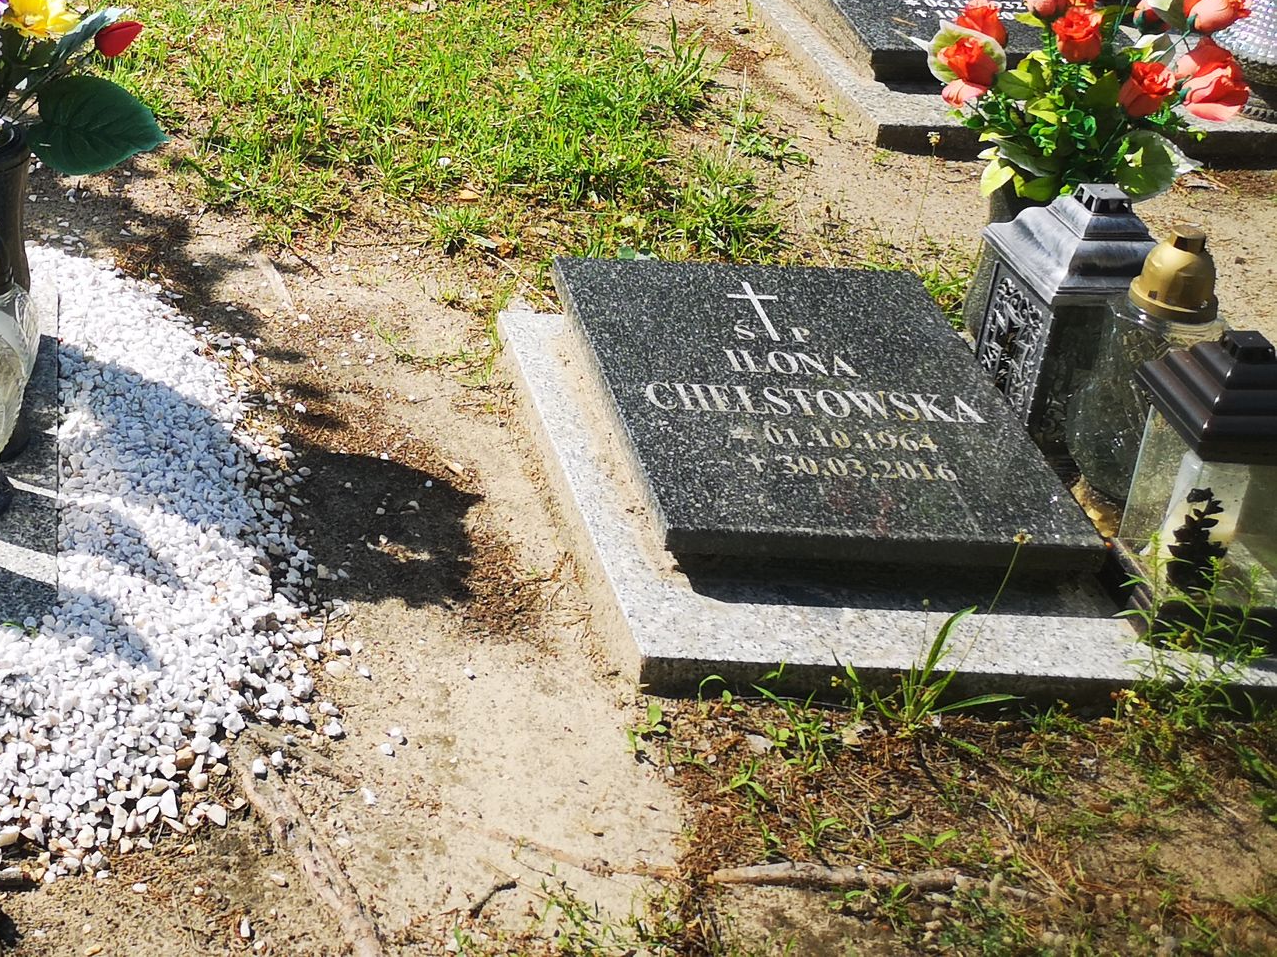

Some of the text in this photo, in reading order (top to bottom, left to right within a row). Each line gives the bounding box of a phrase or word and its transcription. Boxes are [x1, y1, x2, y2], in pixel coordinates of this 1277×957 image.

[734, 320, 811, 342] Ś P
[724, 349, 861, 378] ILONA
[644, 381, 988, 424] CHEŁSTOWSKA
[764, 425, 939, 453] 01.10.1964
[775, 454, 961, 483] 30.03.2016
